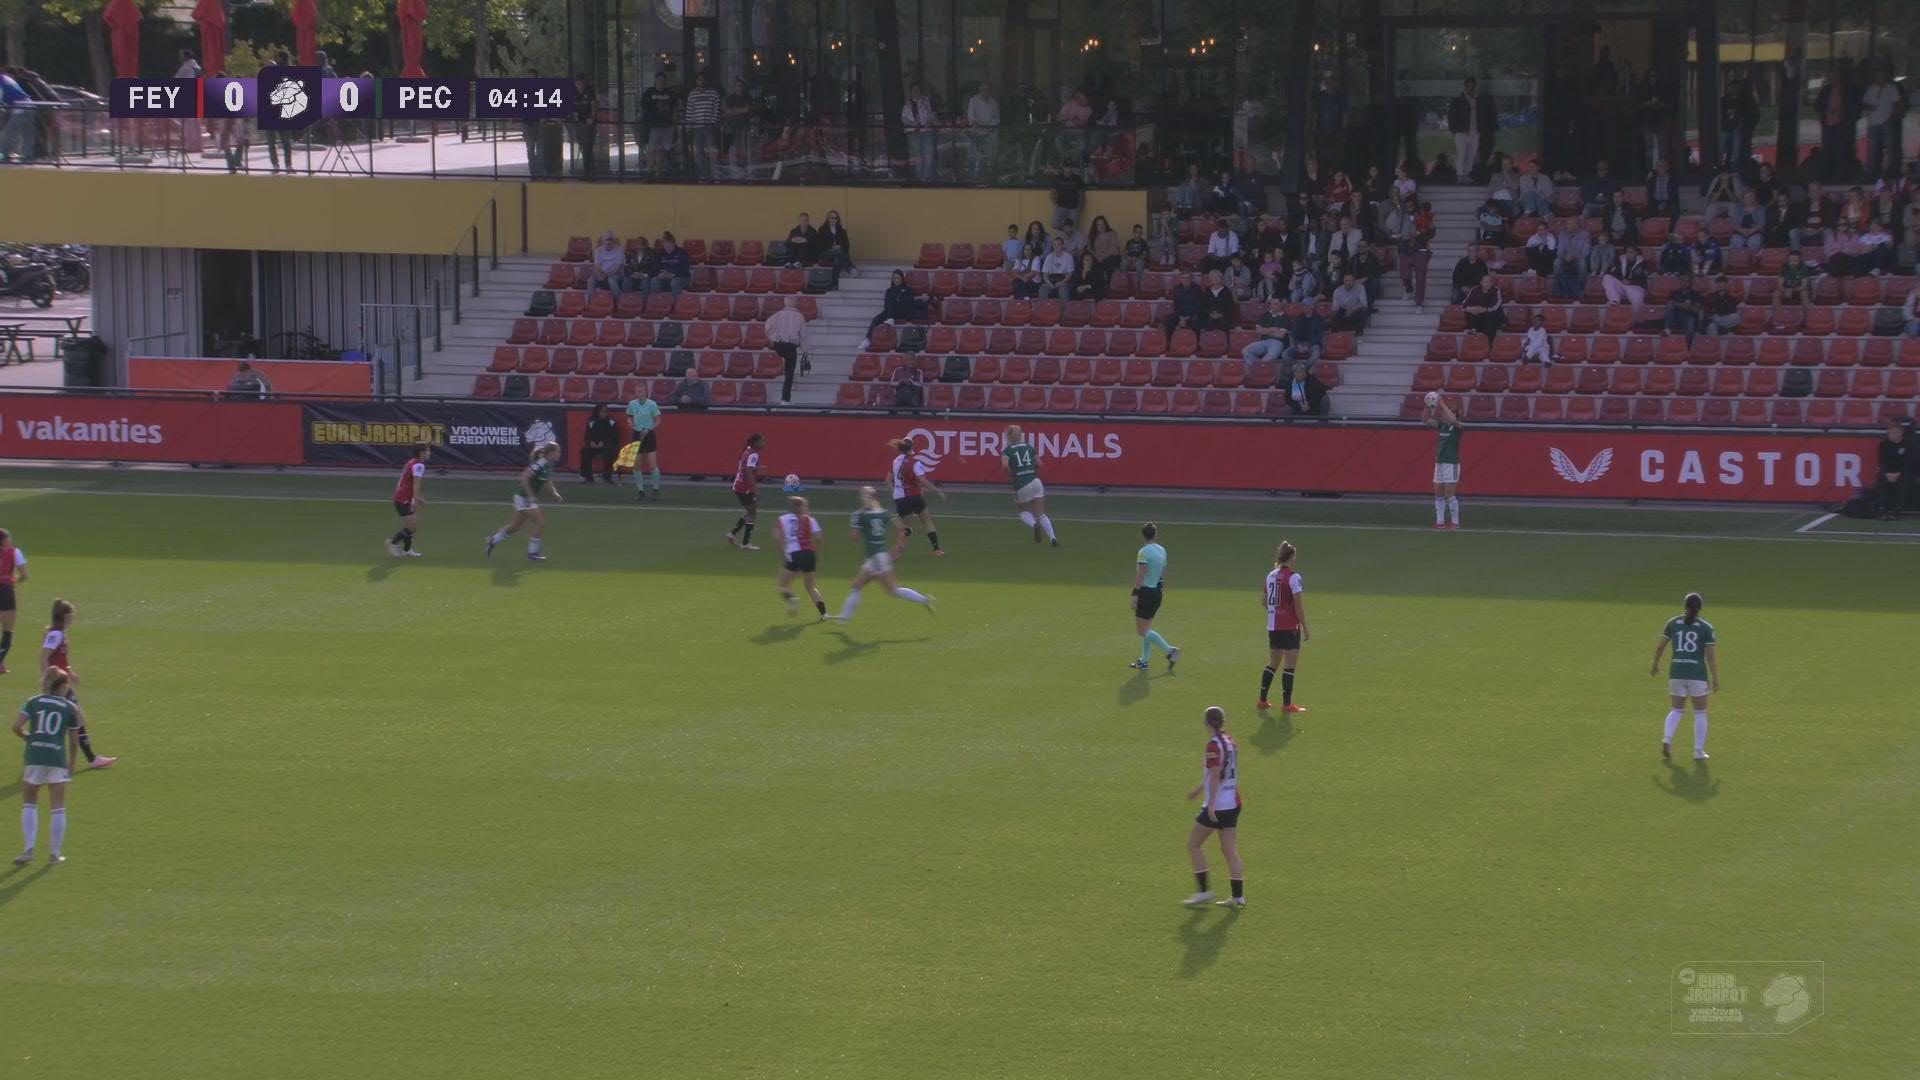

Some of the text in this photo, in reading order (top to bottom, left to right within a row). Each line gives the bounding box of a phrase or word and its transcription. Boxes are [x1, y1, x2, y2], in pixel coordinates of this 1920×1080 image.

[16, 415, 163, 445] vakanties
[313, 421, 445, 446] EUROJACKPOT
[450, 435, 521, 445] EREDIVISIE
[452, 425, 518, 436] VROUWEN
[1013, 450, 1032, 467] 14
[1640, 449, 1863, 488] CASTOR
[1675, 630, 1699, 653] 18
[34, 709, 63, 735] 10
